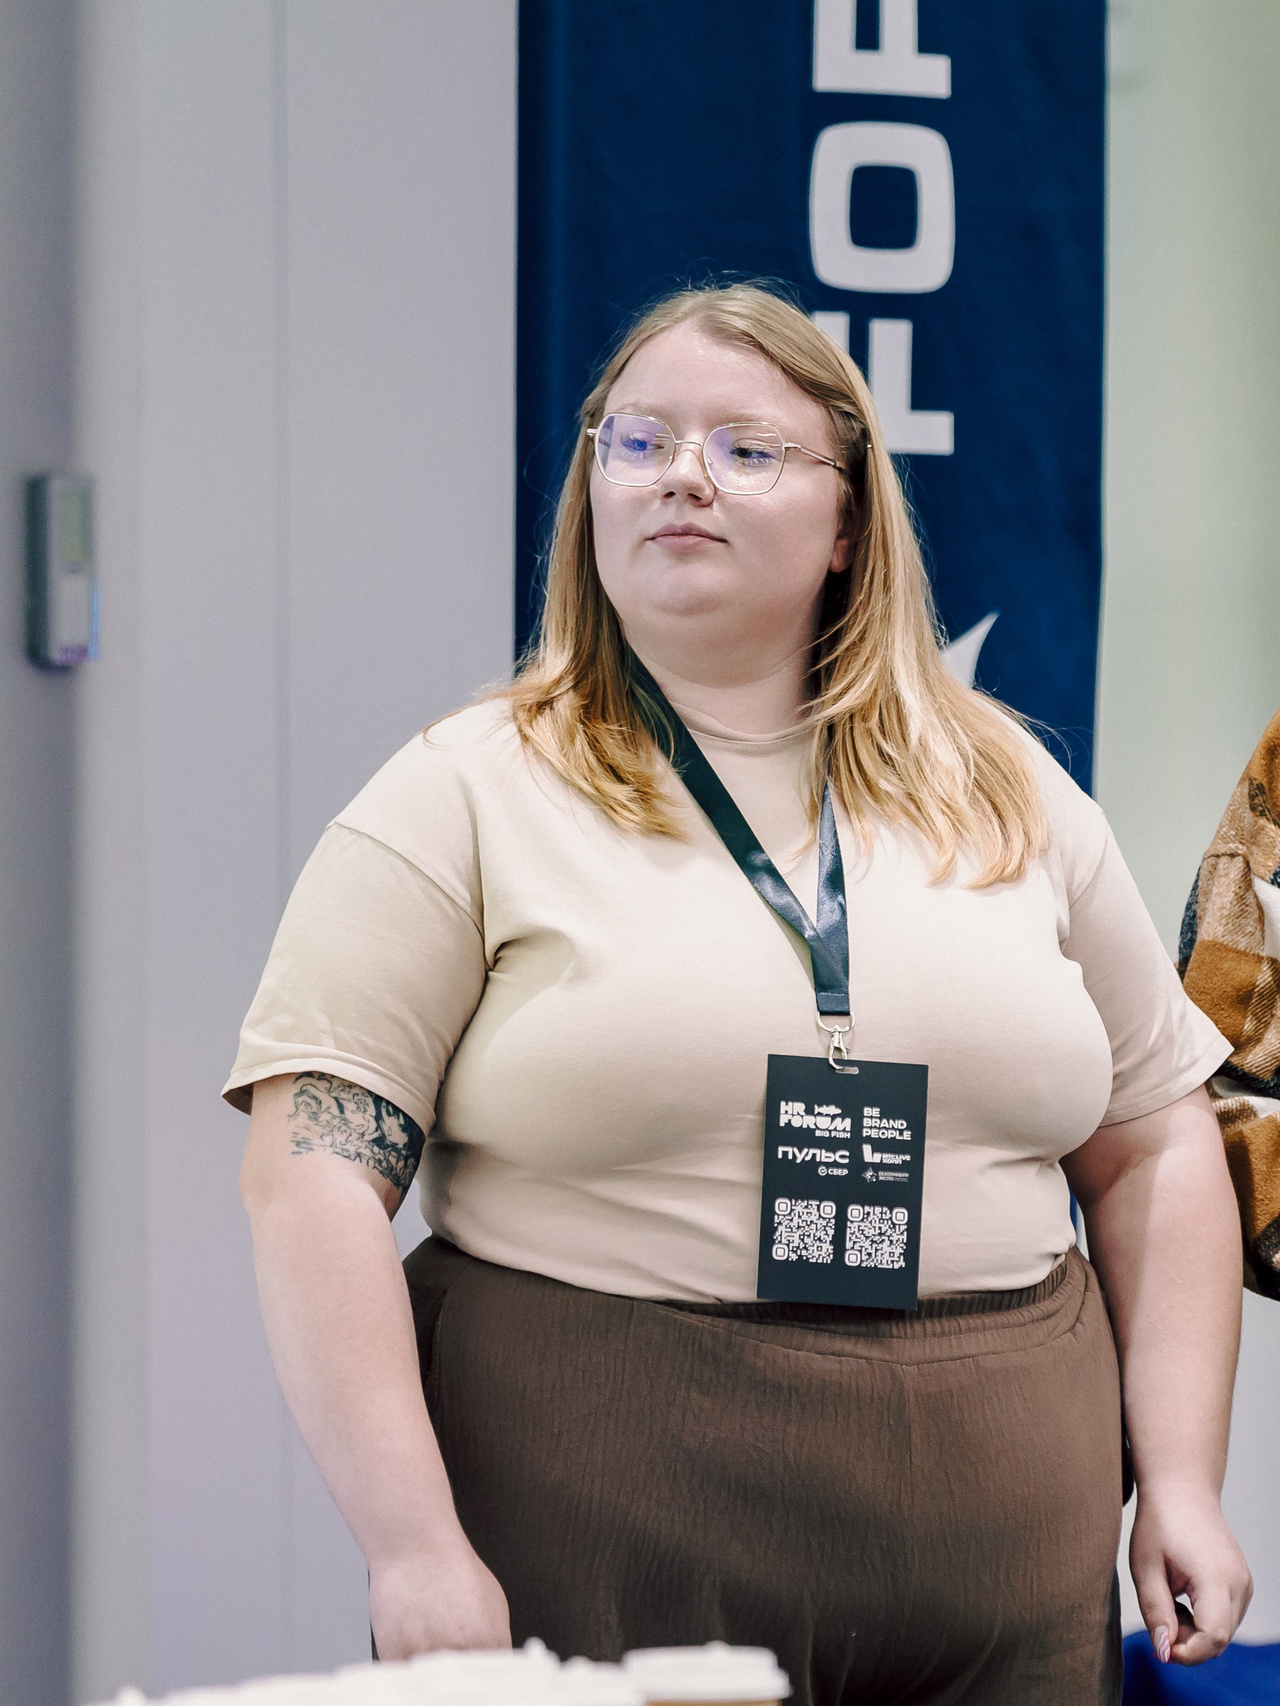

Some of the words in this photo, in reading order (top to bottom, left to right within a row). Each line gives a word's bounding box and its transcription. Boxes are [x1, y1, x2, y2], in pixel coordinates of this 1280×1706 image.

[780, 1101, 806, 1115] HR
[863, 1107, 880, 1117] BE
[779, 1114, 851, 1131] FORUM
[863, 1118, 907, 1130] BRAND
[815, 1130, 830, 1138] BIG
[831, 1131, 851, 1139] FISH
[862, 1128, 912, 1140] PEOPLE
[828, 1168, 849, 1176] СБЕР
